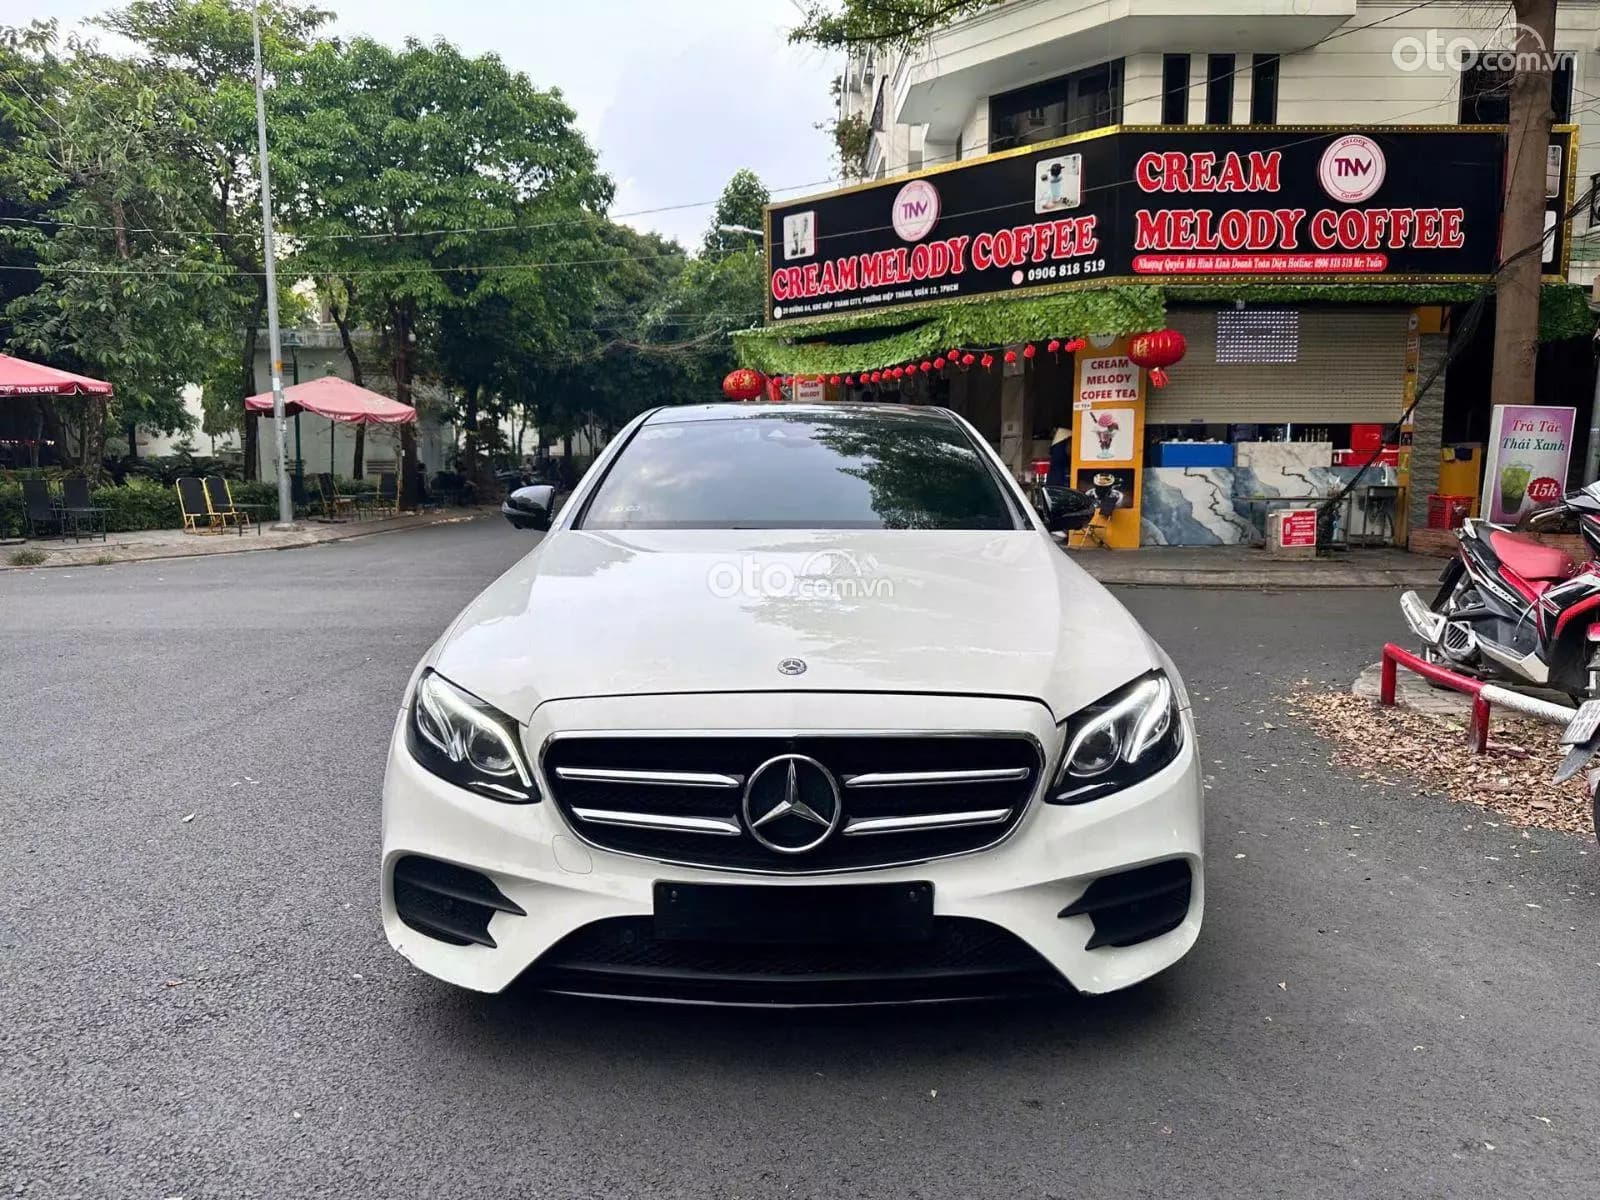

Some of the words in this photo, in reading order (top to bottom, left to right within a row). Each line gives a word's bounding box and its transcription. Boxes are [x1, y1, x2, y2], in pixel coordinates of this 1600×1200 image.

[1136, 151, 1281, 193] CREAM
[1135, 209, 1306, 250] MELODY
[1311, 208, 1465, 250] COFFEE
[771, 256, 858, 301] CREAM
[859, 235, 969, 289] MELODY
[971, 215, 1099, 271] COFFEE
[1028, 266, 1056, 282] 0906
[1059, 264, 1080, 277] 818
[1084, 259, 1106, 274] 519
[1091, 359, 1129, 370] CREAM
[1086, 374, 1132, 385] MELODY
[1081, 388, 1113, 400] COFEE
[1115, 388, 1137, 399] TEA
[1512, 419, 1534, 432] Trà
[1502, 437, 1531, 450] Thái
[1533, 438, 1566, 451] Xanh
[1531, 483, 1558, 497] 15k
